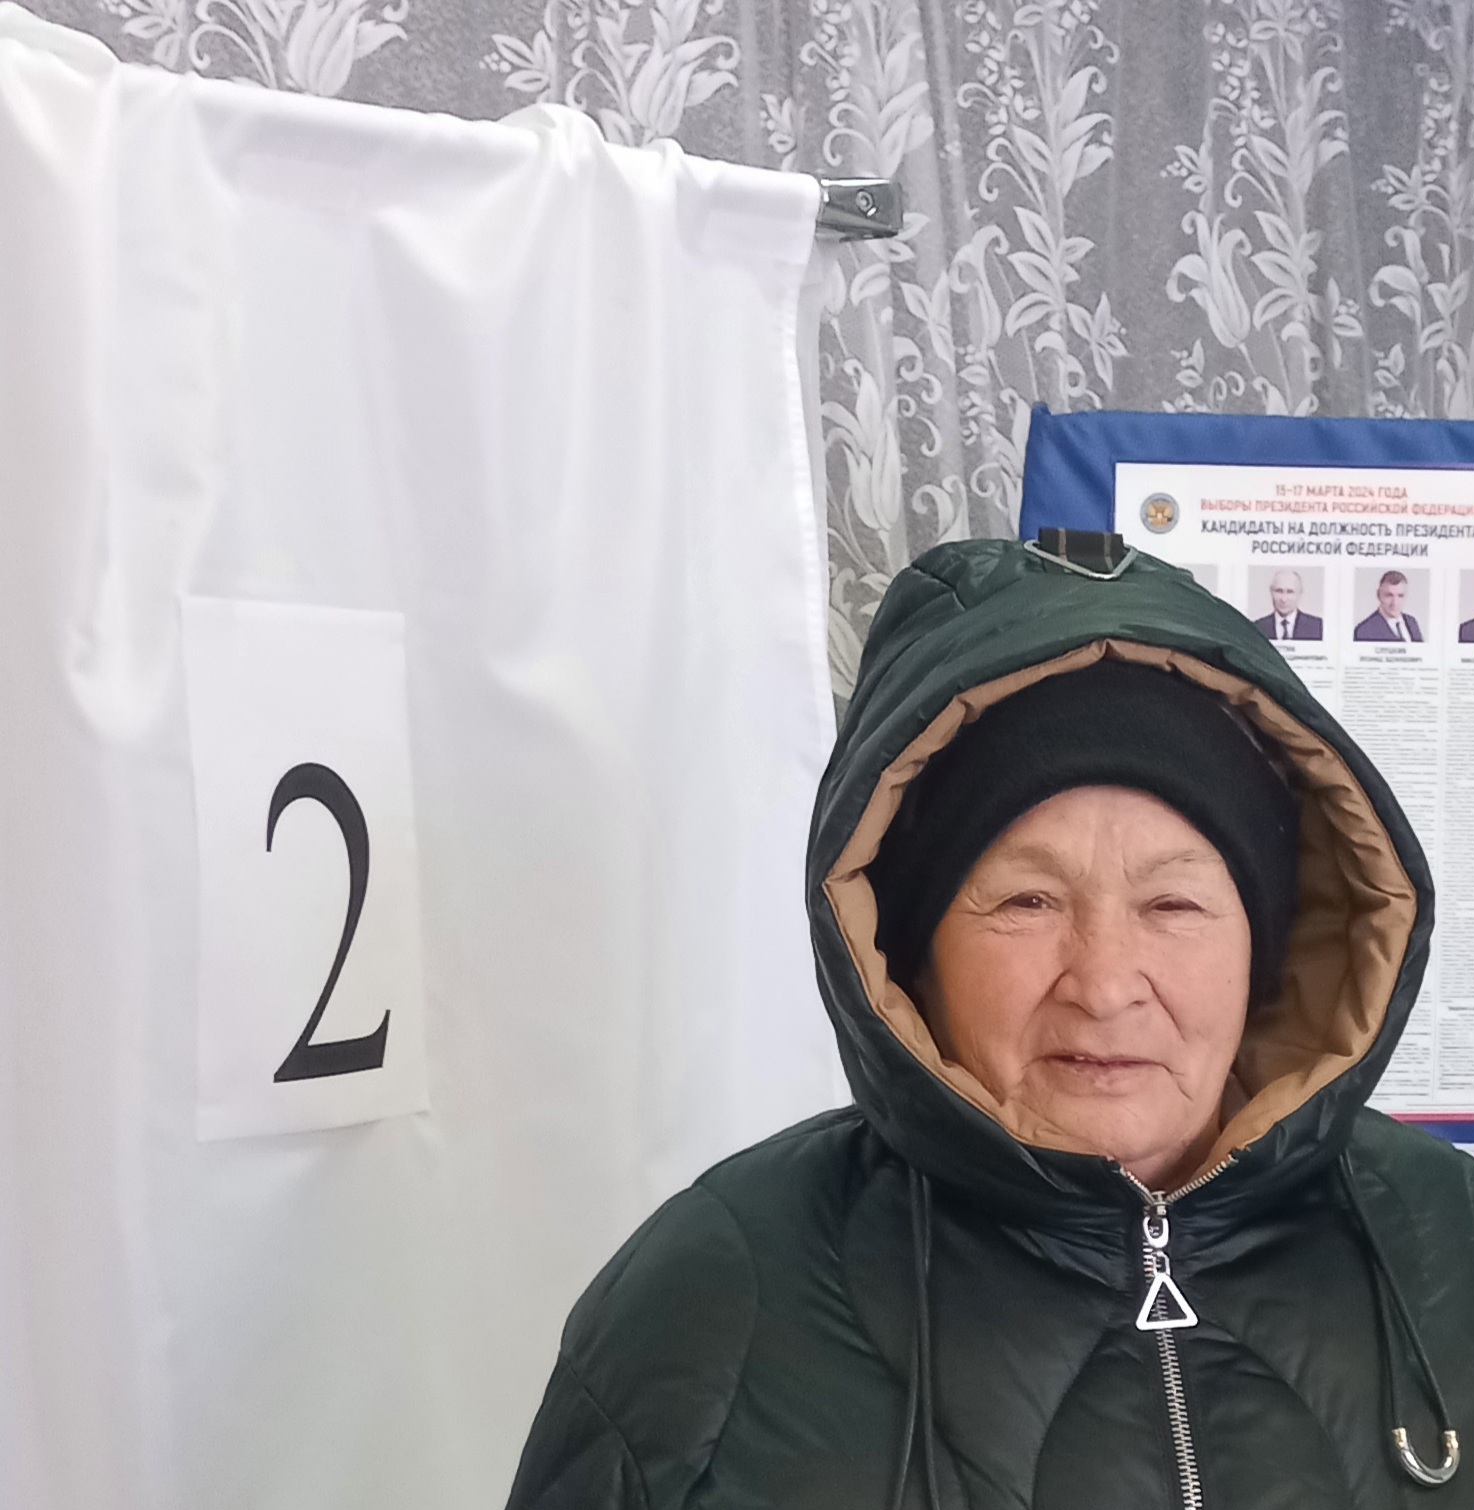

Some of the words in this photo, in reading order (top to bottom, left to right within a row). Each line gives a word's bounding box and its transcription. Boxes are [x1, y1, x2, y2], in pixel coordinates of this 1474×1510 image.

[1306, 485, 1344, 497] МАРТА
[1347, 485, 1375, 497] 2024
[1378, 486, 1409, 499] ГОДА
[1200, 501, 1251, 512] ВЫБОРЫ
[1255, 501, 1328, 514] ПРЕЗИДЕНТА
[1332, 500, 1408, 515] РОССИЙСКОЙ
[1201, 520, 1284, 535] КАНДИДАТЫ
[1288, 522, 1305, 534] НА
[1309, 522, 1392, 537] ДОЛЖНОСТЬ
[1251, 538, 1341, 555] РОССИЙСКОЙ
[1345, 541, 1428, 557] ФЕДЕРАЦИИ
[266, 762, 392, 1083] 2
